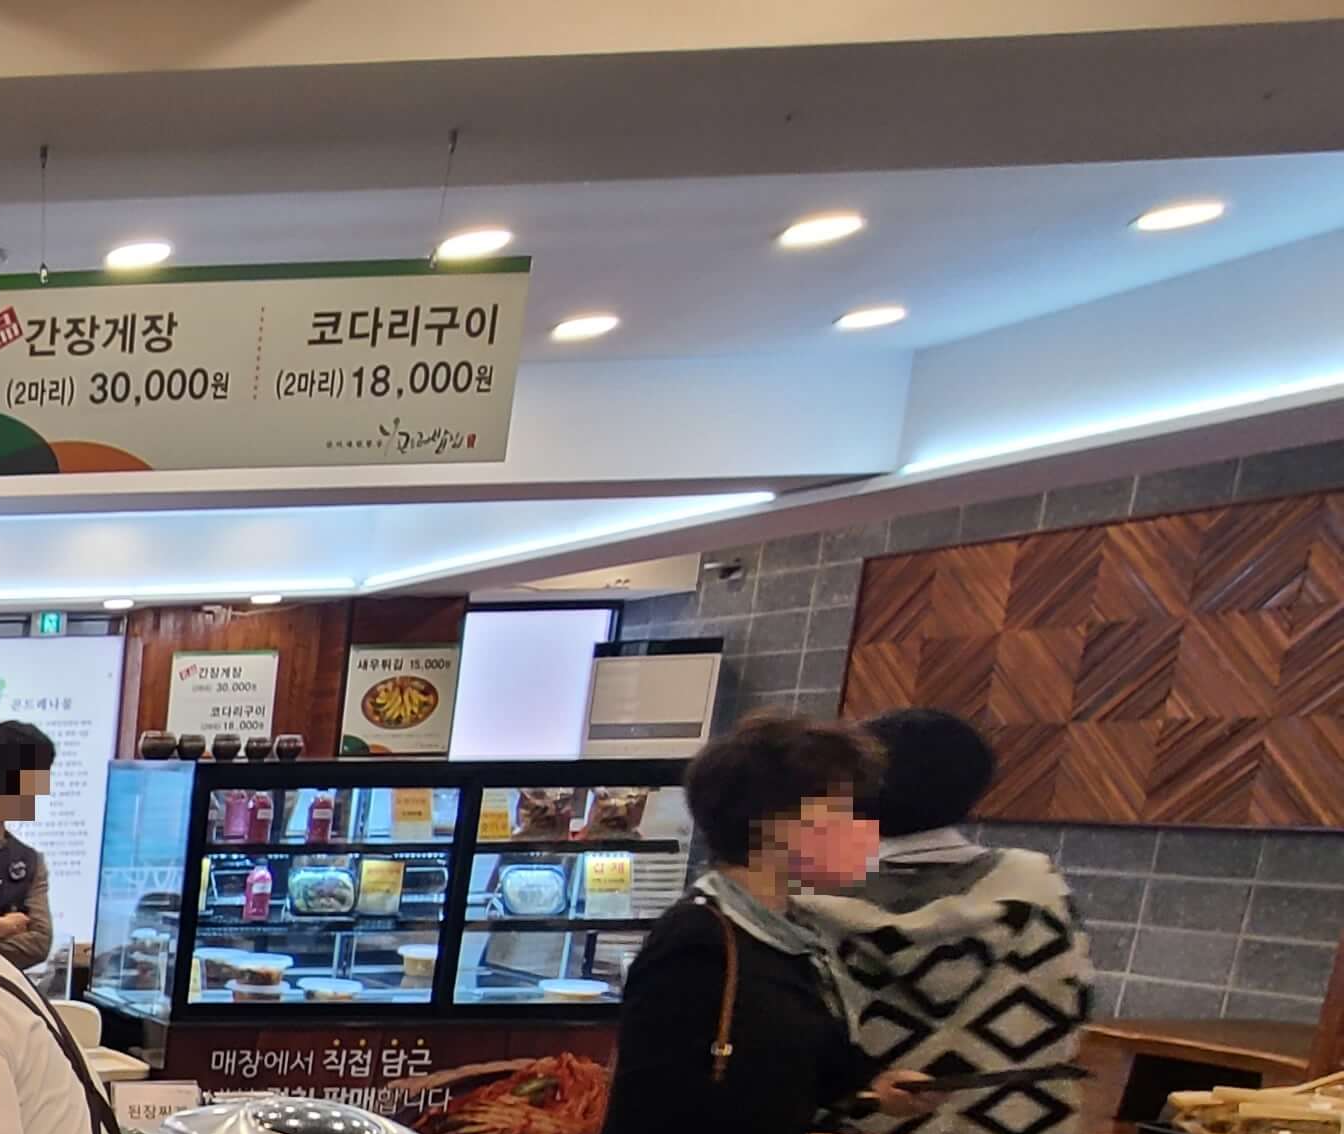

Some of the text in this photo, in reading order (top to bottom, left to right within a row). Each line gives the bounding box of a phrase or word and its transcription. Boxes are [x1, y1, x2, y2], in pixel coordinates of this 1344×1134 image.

[24, 310, 179, 358] 간장게장
[307, 303, 498, 349] 코다리구이
[5, 367, 231, 409] (2마리) 30,000원
[274, 360, 495, 400] (2마리) 18,000원
[357, 658, 404, 671] 새우튀김
[212, 1048, 433, 1078] 매장에서 직접 담근
